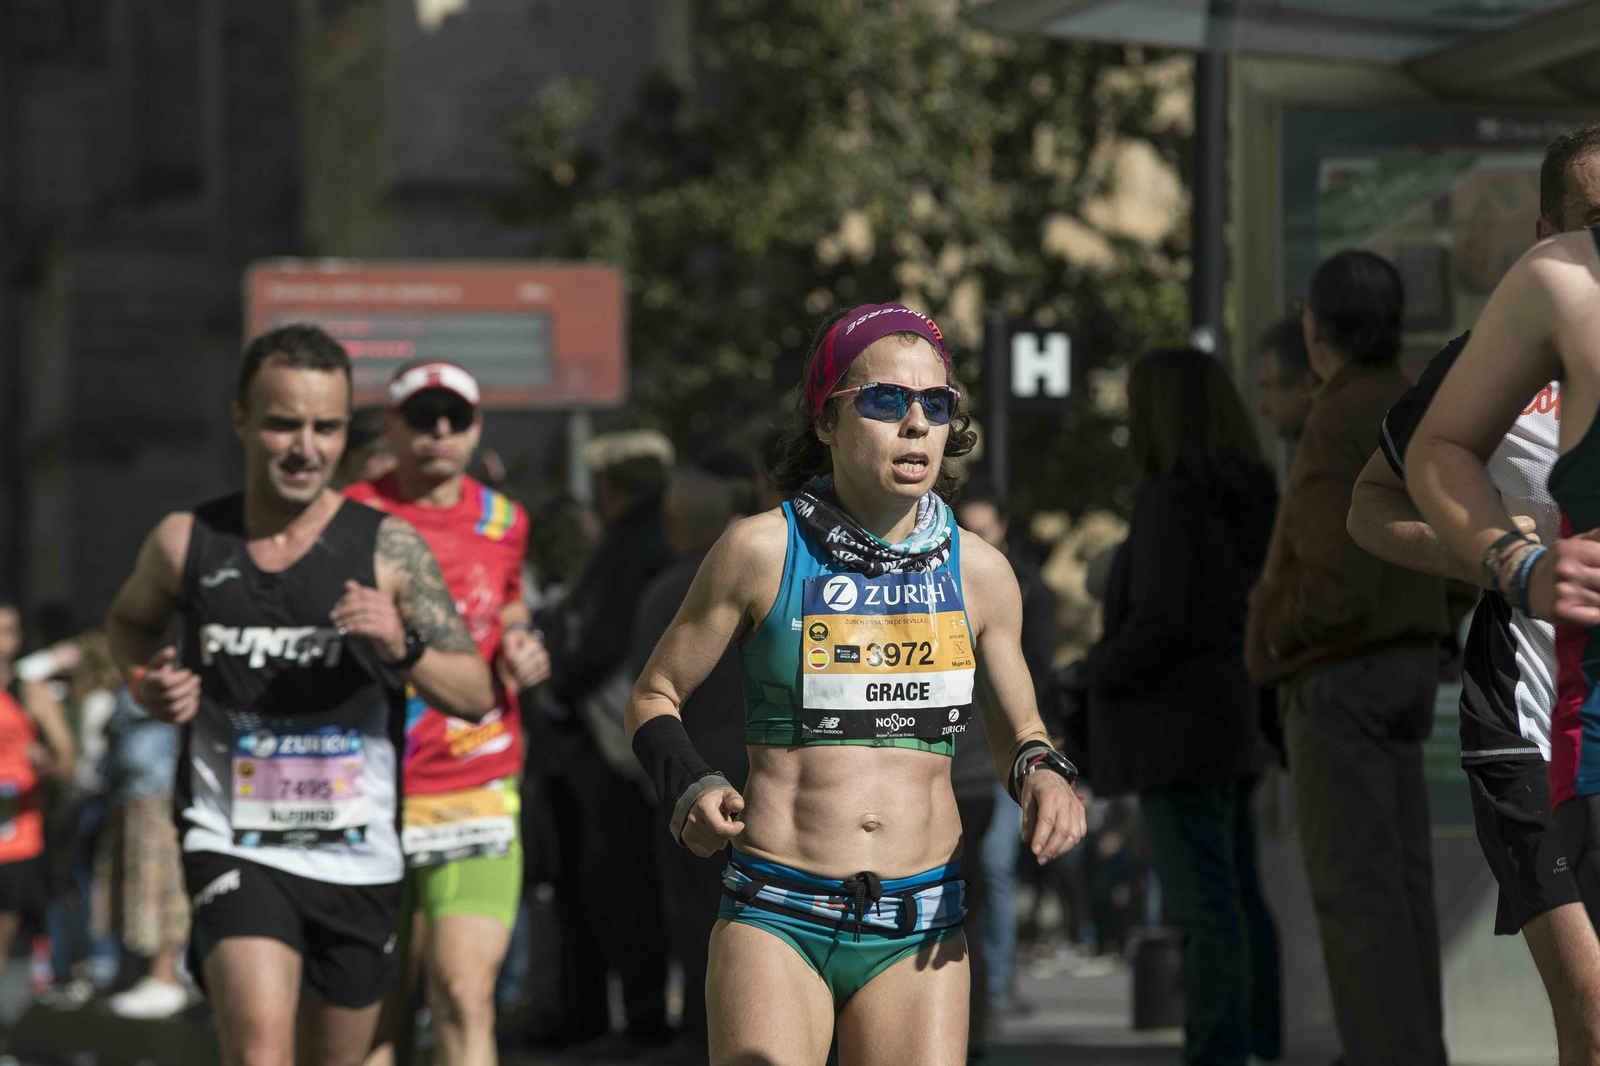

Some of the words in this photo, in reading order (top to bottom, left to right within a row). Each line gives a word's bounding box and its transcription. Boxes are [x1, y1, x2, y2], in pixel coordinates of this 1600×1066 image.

[846, 308, 926, 335] INVERSE
[1011, 332, 1071, 398] H
[866, 641, 934, 667] 3972
[865, 682, 930, 702] GRACE
[942, 725, 966, 735] ZURICH
